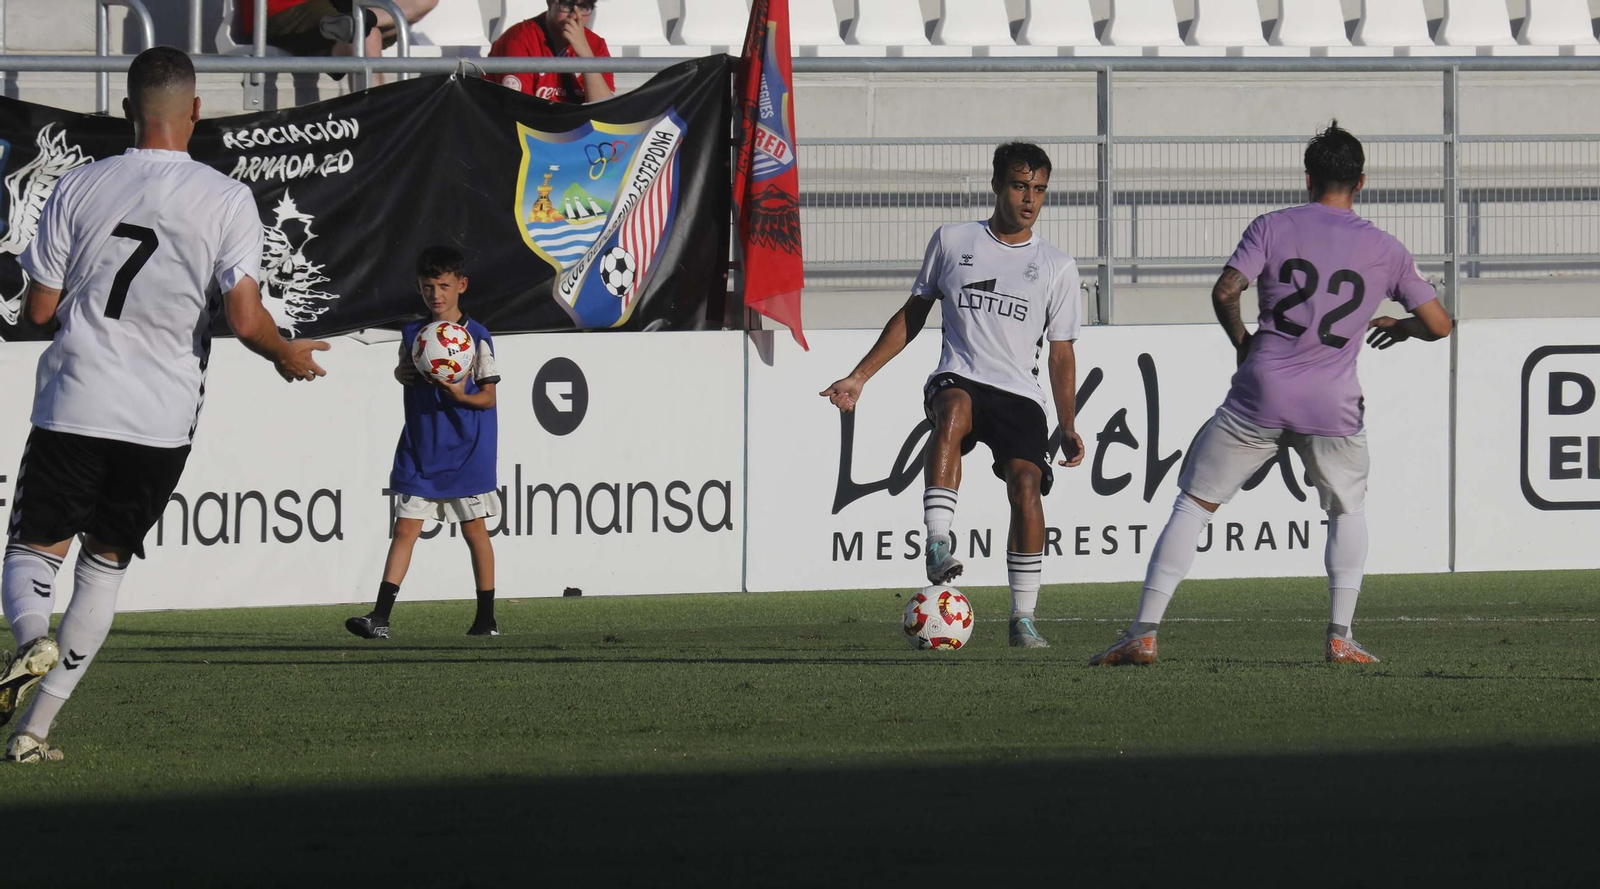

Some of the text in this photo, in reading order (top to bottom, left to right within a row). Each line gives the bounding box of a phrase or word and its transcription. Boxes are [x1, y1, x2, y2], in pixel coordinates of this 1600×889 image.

[223, 112, 359, 150] ASOCIACIÓN
[754, 127, 788, 159] RED
[229, 153, 316, 182] ARMADA
[561, 261, 585, 295] CLUB
[632, 130, 675, 195] ESTEPONA
[103, 222, 160, 321] 7
[958, 293, 1029, 322] LOTUS
[1272, 257, 1366, 349] 22
[832, 519, 1331, 562] MESN RESTURAN
